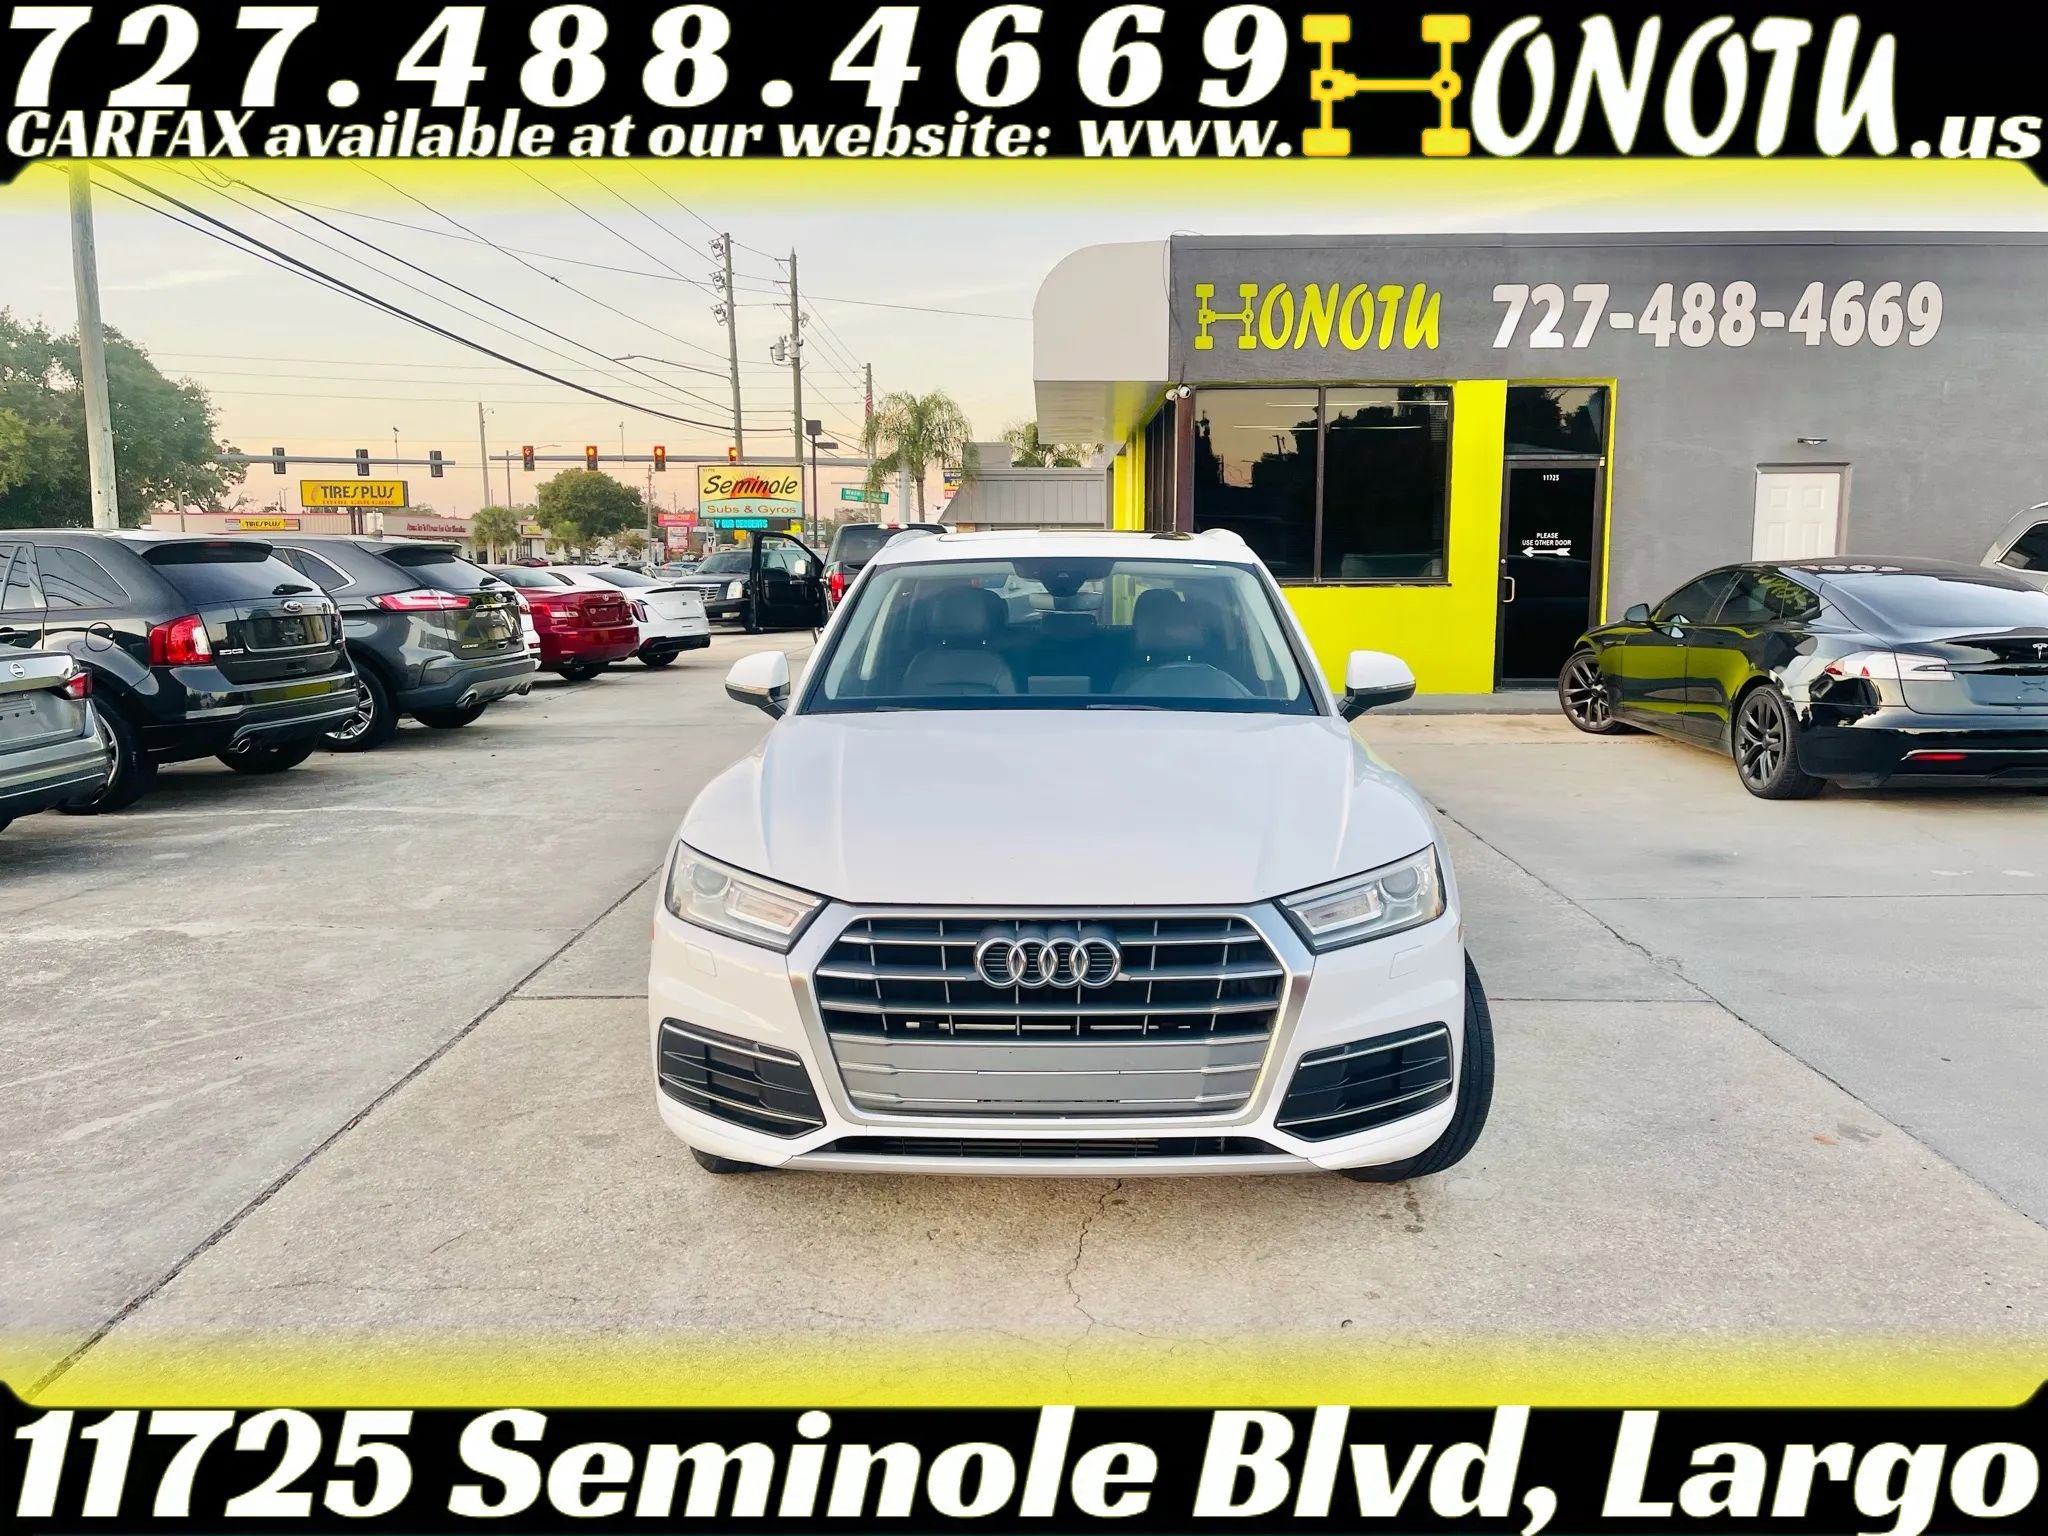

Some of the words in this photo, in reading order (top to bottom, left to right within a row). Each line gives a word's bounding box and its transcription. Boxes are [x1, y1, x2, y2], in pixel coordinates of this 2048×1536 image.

[1490, 279, 1945, 350] 727-488-4669
[320, 485, 358, 499] TIRES
[361, 485, 395, 499] PLUS
[703, 474, 798, 495] Seminole
[706, 504, 740, 514] Subs
[743, 504, 753, 513] &
[757, 504, 797, 515] Gyros
